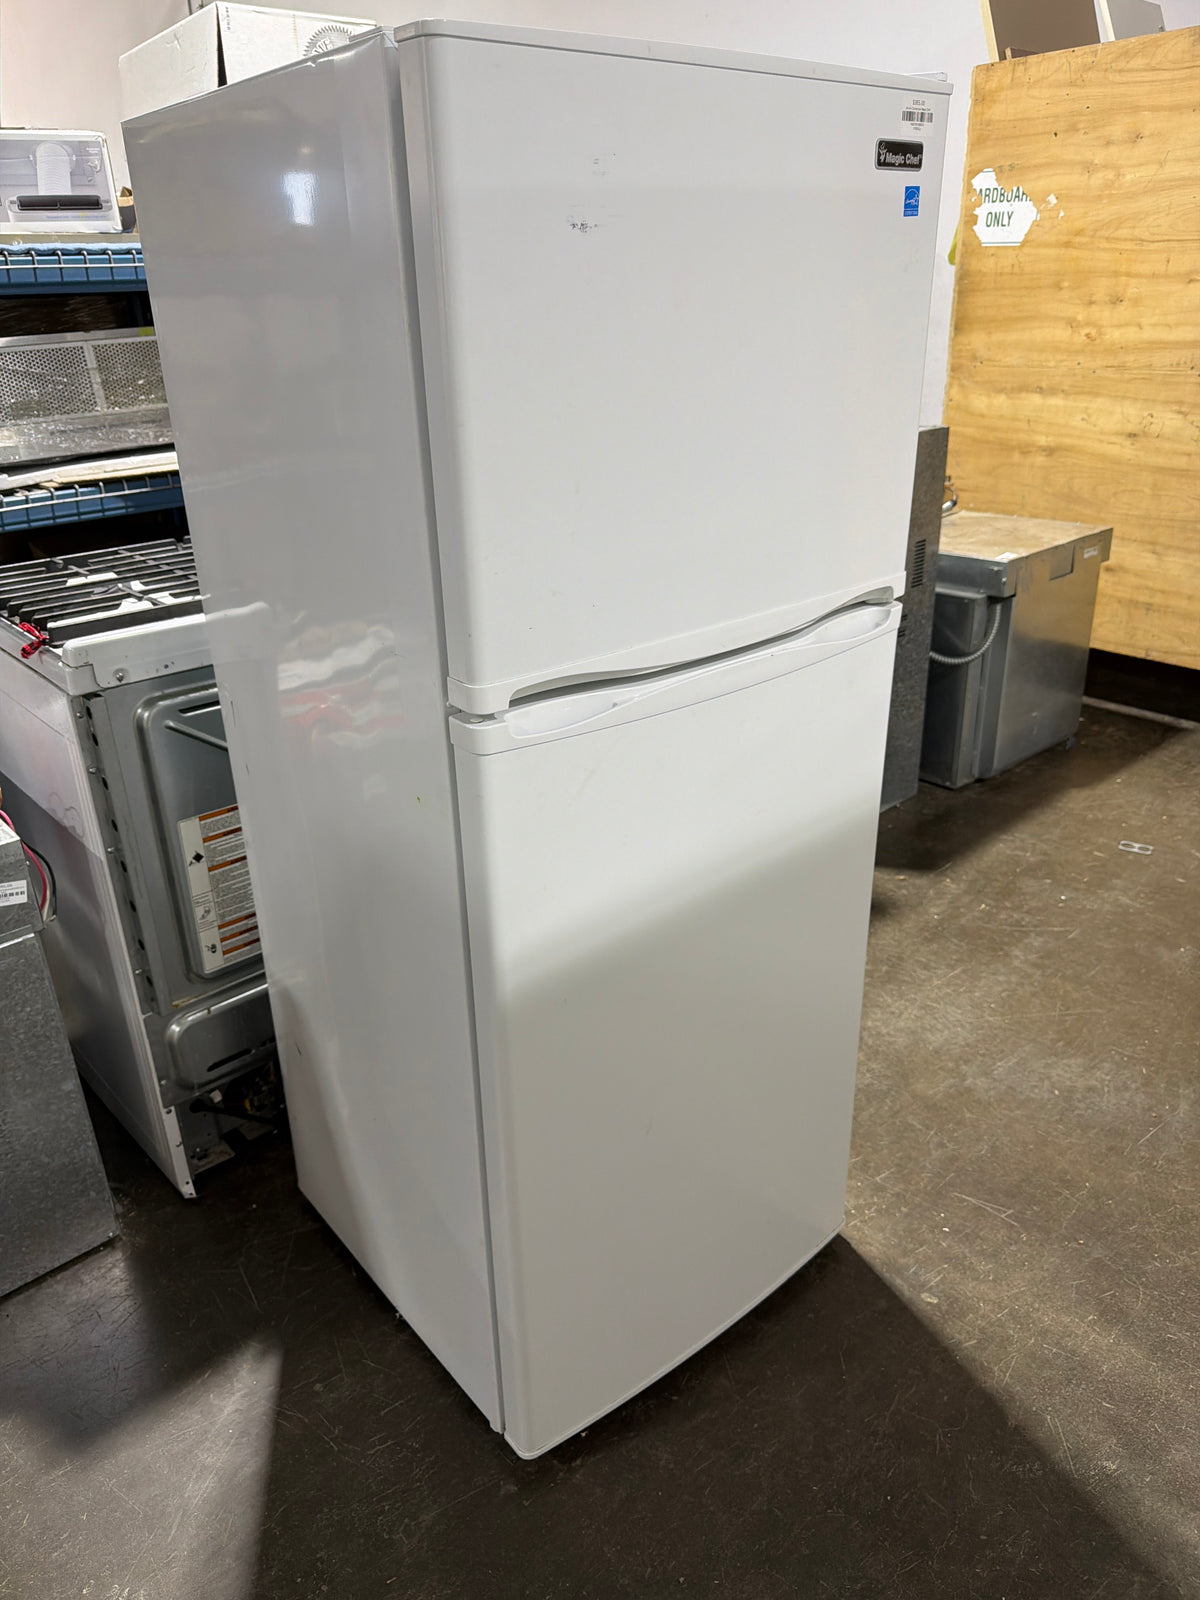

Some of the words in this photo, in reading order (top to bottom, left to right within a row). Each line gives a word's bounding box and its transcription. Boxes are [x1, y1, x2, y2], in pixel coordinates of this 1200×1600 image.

[885, 152, 905, 166] Magic
[905, 153, 920, 165] Chef
[977, 186, 1031, 204] ARDBOAR
[985, 210, 1014, 228] ONLY
